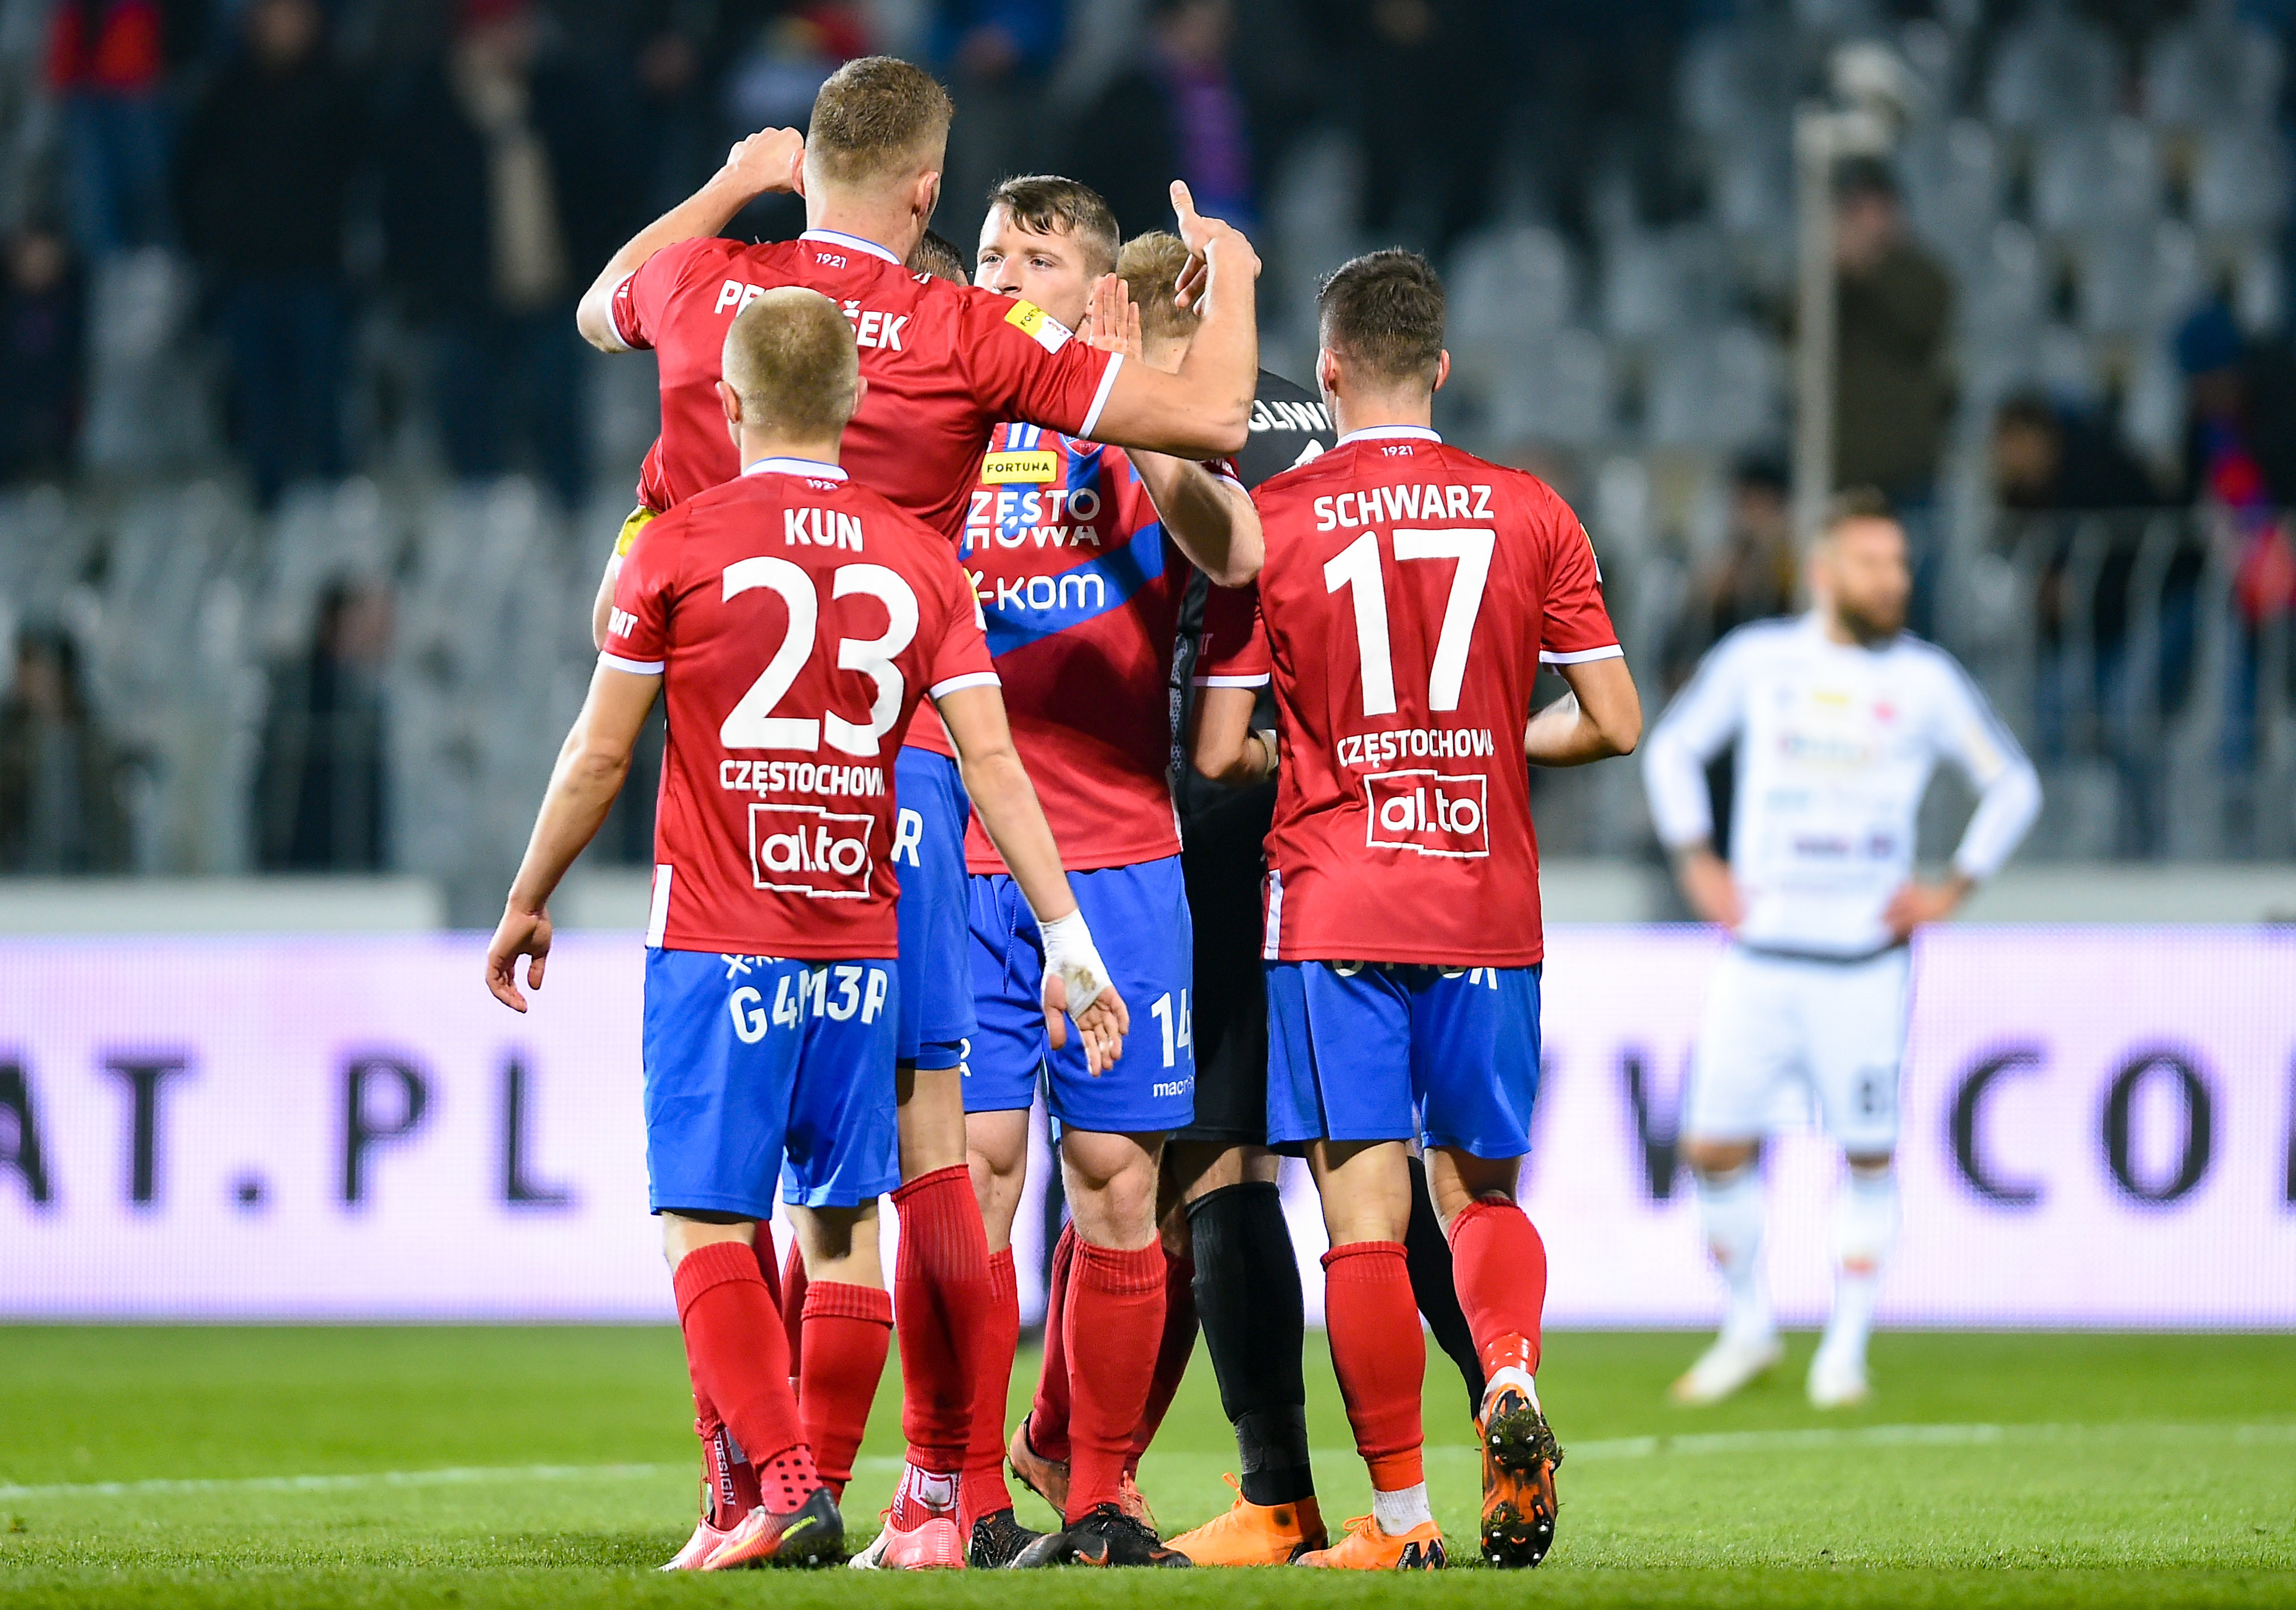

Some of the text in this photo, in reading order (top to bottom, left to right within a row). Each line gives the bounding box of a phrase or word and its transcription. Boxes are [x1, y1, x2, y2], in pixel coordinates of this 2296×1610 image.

[816, 253, 847, 269] 1921
[987, 463, 1050, 473] FORTUNA
[1382, 445, 1413, 457] 1921
[806, 479, 839, 489] 1921
[1314, 484, 1494, 531] SCHWARZ
[784, 507, 864, 553] KUN
[1323, 528, 1496, 716] 17
[719, 556, 919, 756] 23
[1337, 729, 1494, 768] CZĘSTOCHOW
[720, 760, 885, 798] CZĘSTOCHOW
[1380, 787, 1480, 834] al.to
[1151, 988, 1191, 1067] 14
